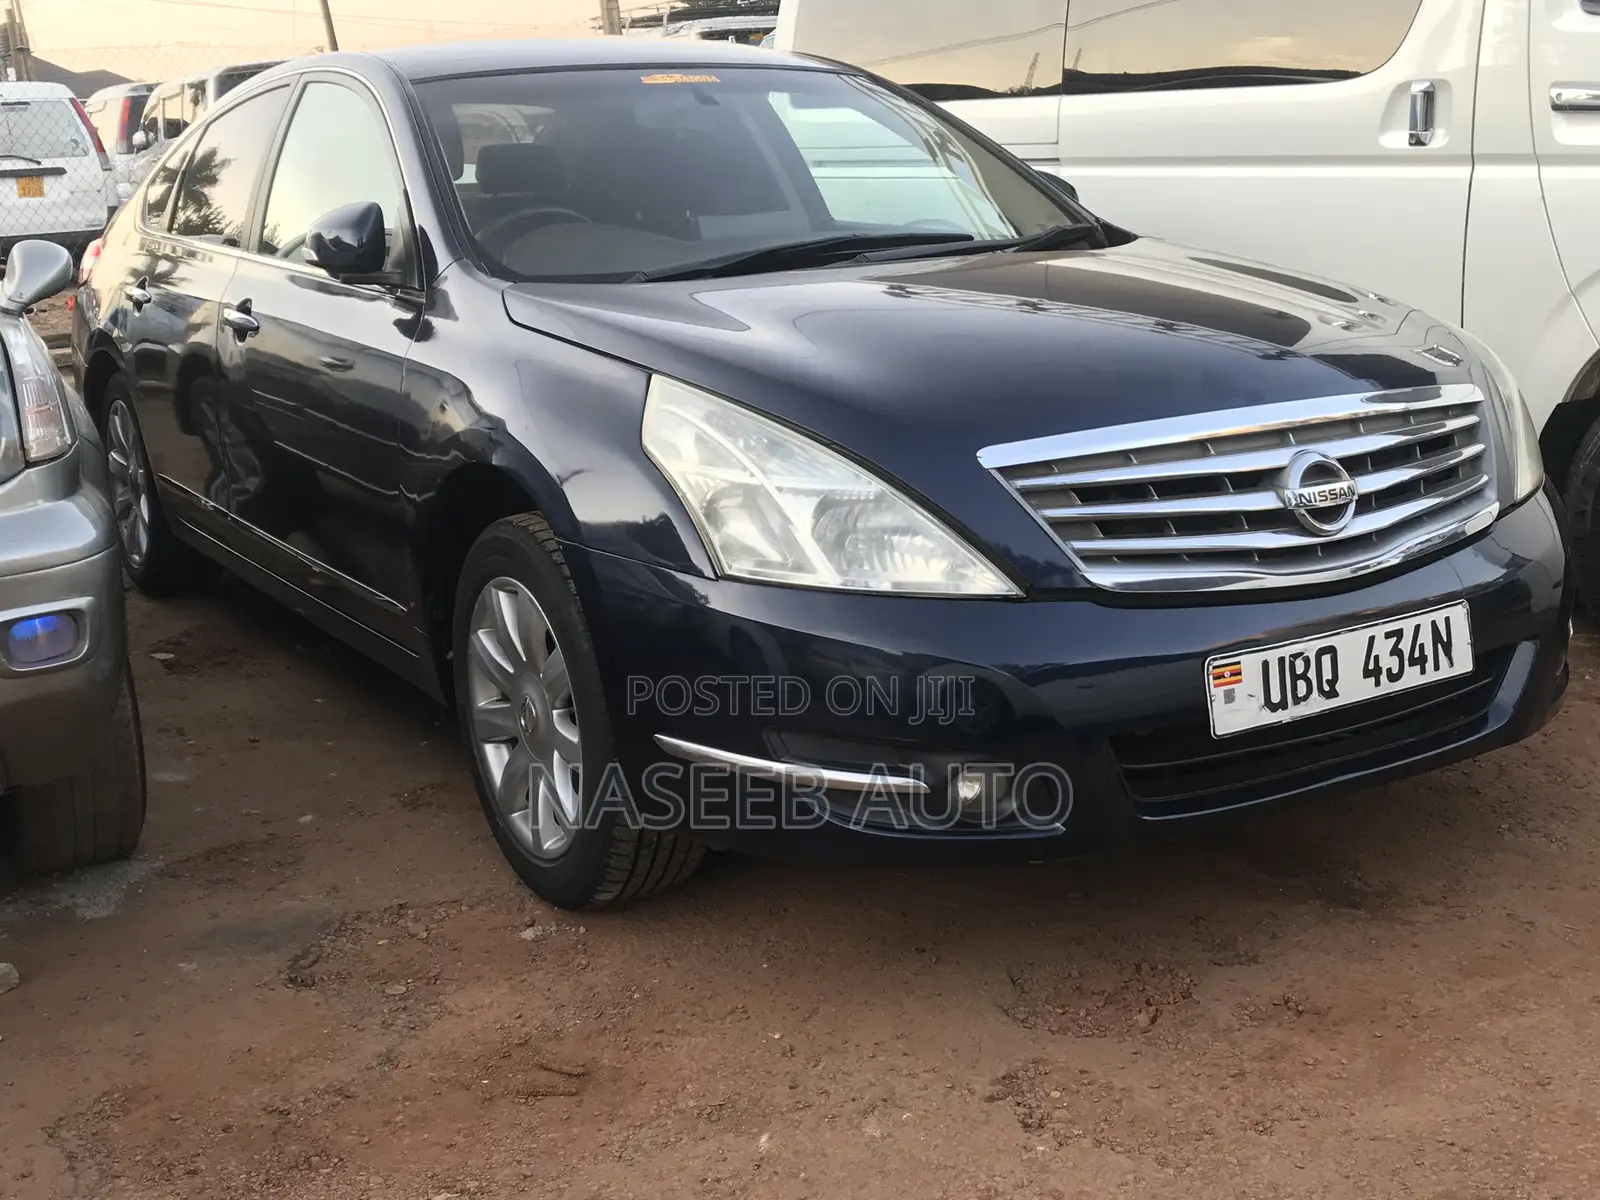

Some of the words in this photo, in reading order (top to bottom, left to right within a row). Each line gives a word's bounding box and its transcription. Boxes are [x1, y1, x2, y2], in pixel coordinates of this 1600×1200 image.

[1298, 484, 1356, 504] NISSAN
[1261, 645, 1340, 713] UBQ
[1362, 616, 1454, 687] 434N
